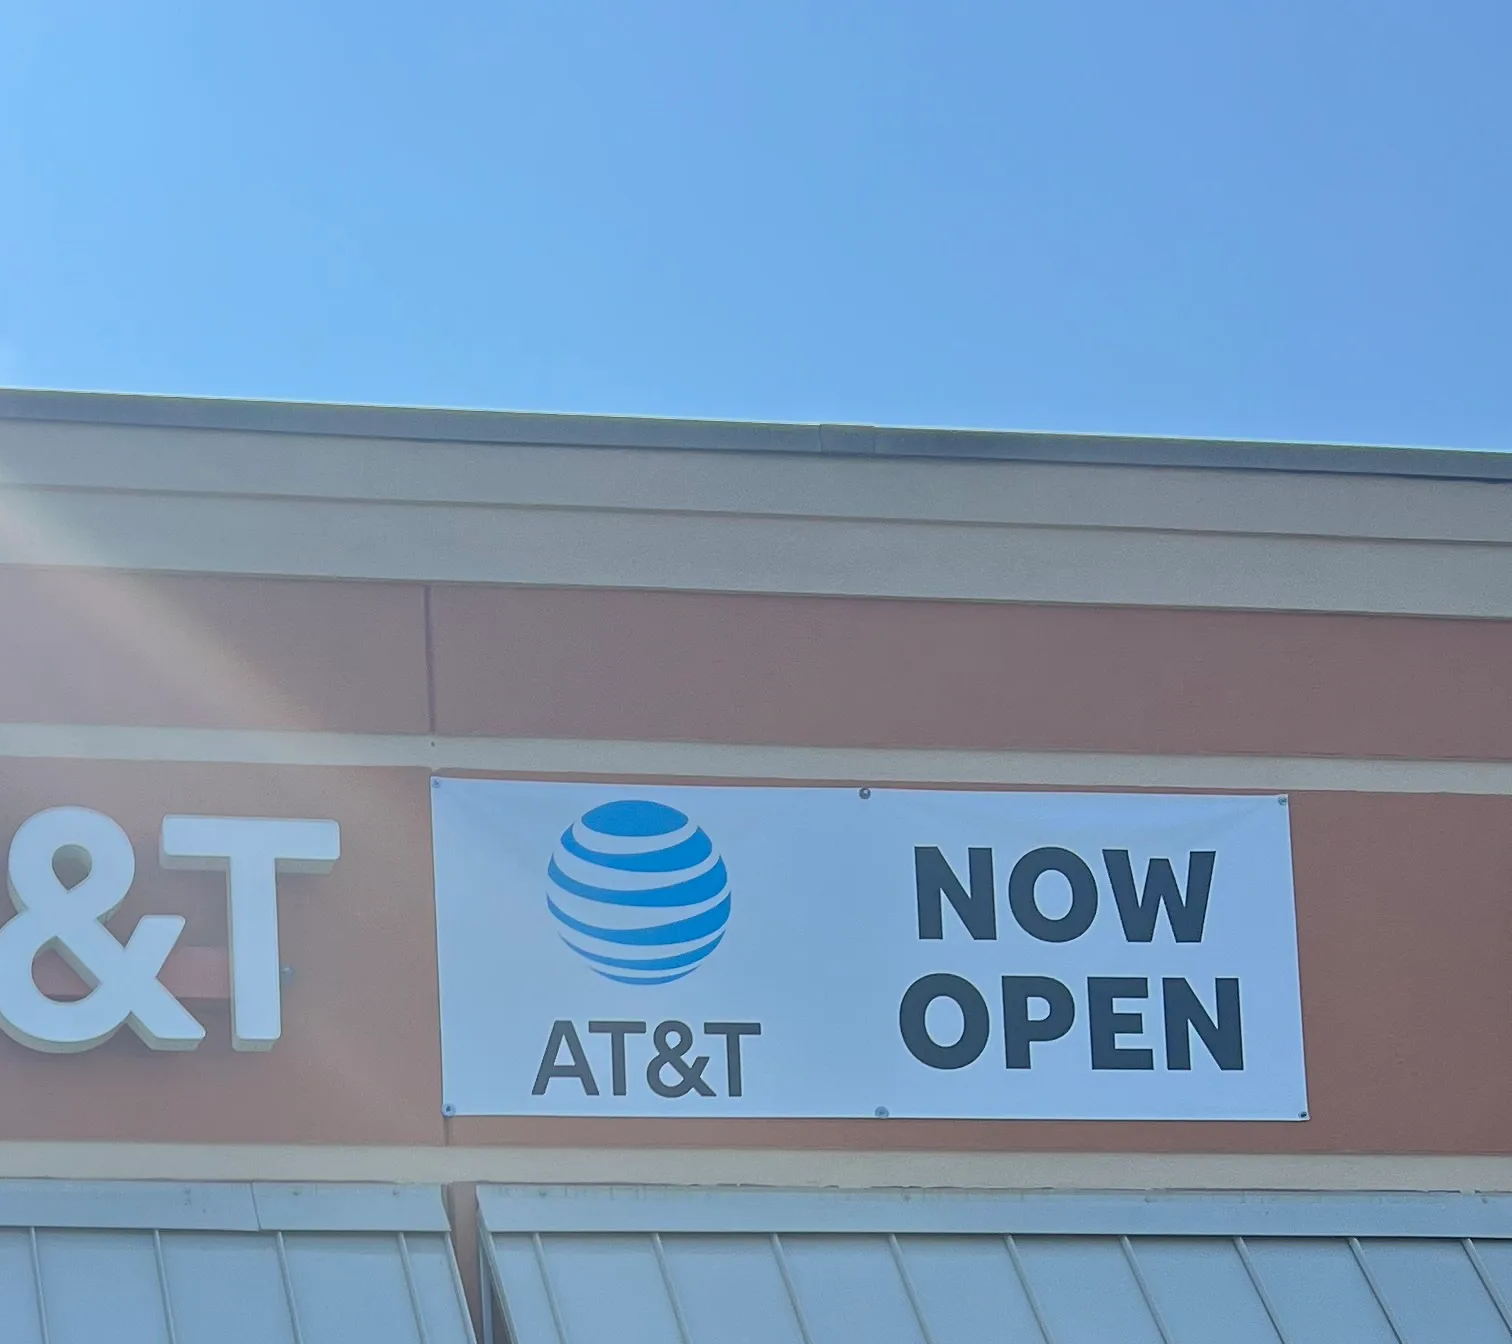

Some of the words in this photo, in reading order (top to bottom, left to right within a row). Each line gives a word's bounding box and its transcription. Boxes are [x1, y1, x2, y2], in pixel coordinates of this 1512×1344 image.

[913, 845, 1217, 944] NOW
[531, 1020, 762, 1099] AT&T
[898, 972, 1245, 1071] OPEN
